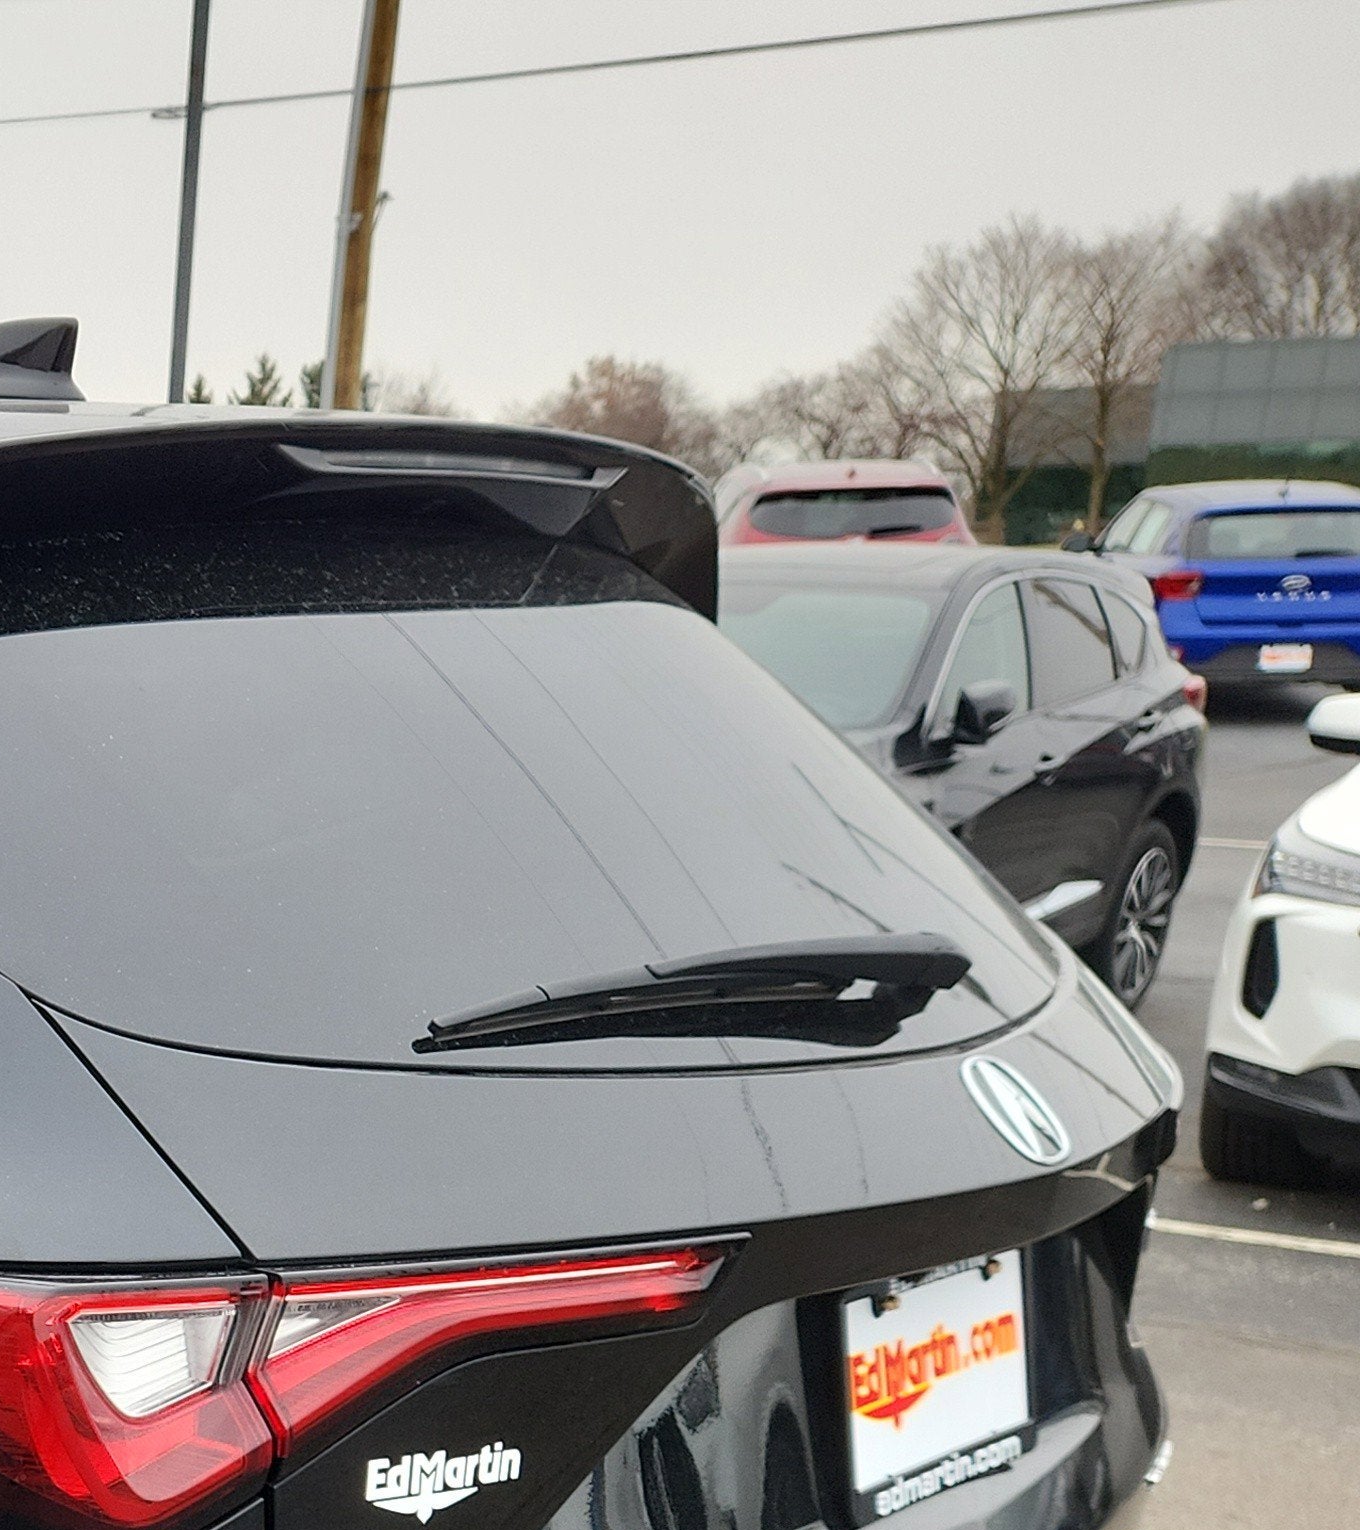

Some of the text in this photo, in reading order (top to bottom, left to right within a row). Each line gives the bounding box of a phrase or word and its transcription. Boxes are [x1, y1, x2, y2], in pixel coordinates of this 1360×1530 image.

[847, 1313, 1018, 1410] EdMartin.com
[365, 1440, 522, 1506] EdMartin
[874, 1435, 1022, 1516] edmartin.com
